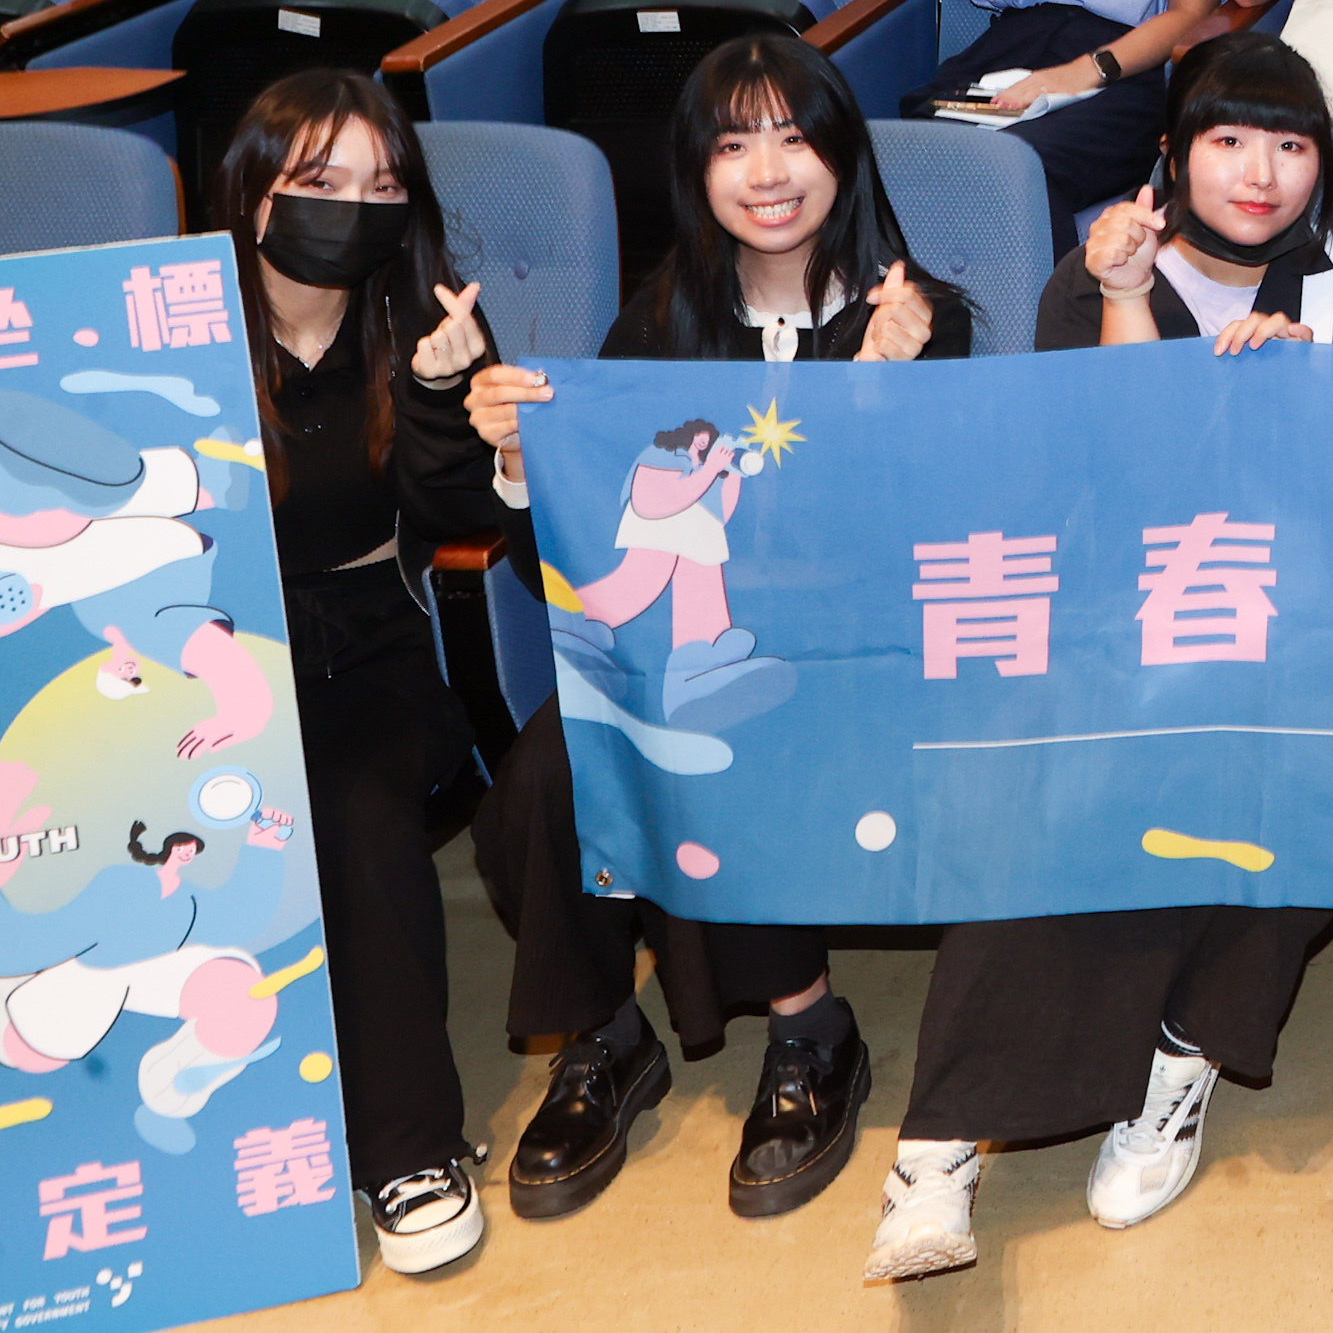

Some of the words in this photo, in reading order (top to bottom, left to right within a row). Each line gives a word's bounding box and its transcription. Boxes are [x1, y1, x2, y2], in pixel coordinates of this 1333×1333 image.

[23, 1295, 46, 1311] FOR
[54, 1285, 91, 1304] YOUTH
[15, 1299, 91, 1328] GOVERNMENT
